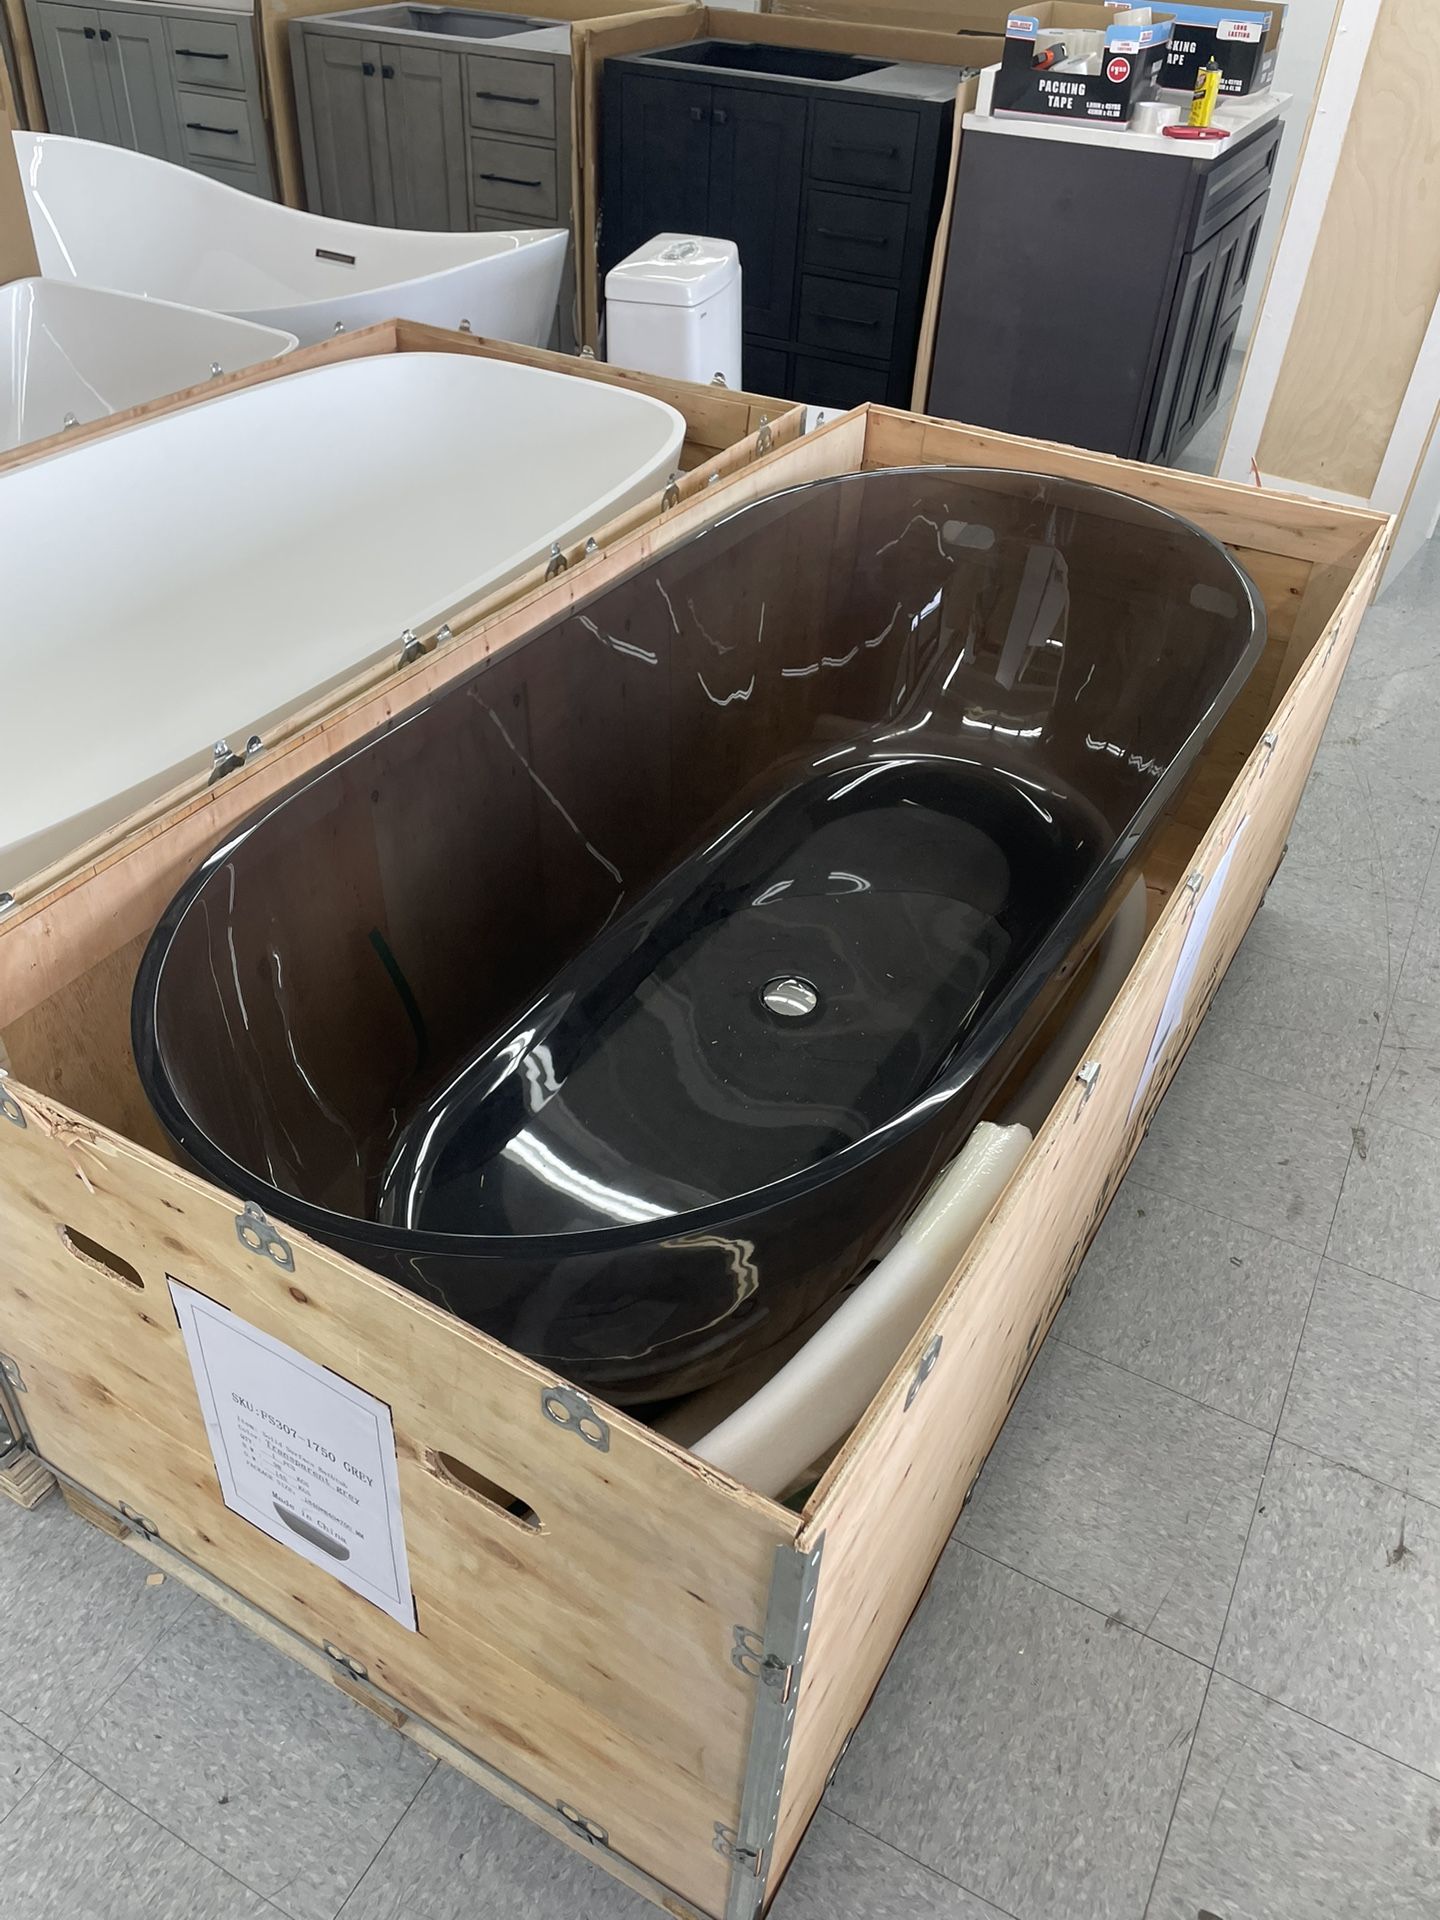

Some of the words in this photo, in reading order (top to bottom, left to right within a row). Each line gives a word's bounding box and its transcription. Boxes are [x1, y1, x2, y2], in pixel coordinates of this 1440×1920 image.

[1038, 79, 1086, 96] PACKING
[1047, 95, 1074, 109] TAPE
[231, 1392, 336, 1463] SKU:FS307-1750
[343, 1462, 373, 1487] GREY
[272, 1491, 294, 1509] Made
[301, 1510, 311, 1520] in
[317, 1520, 346, 1542] China
